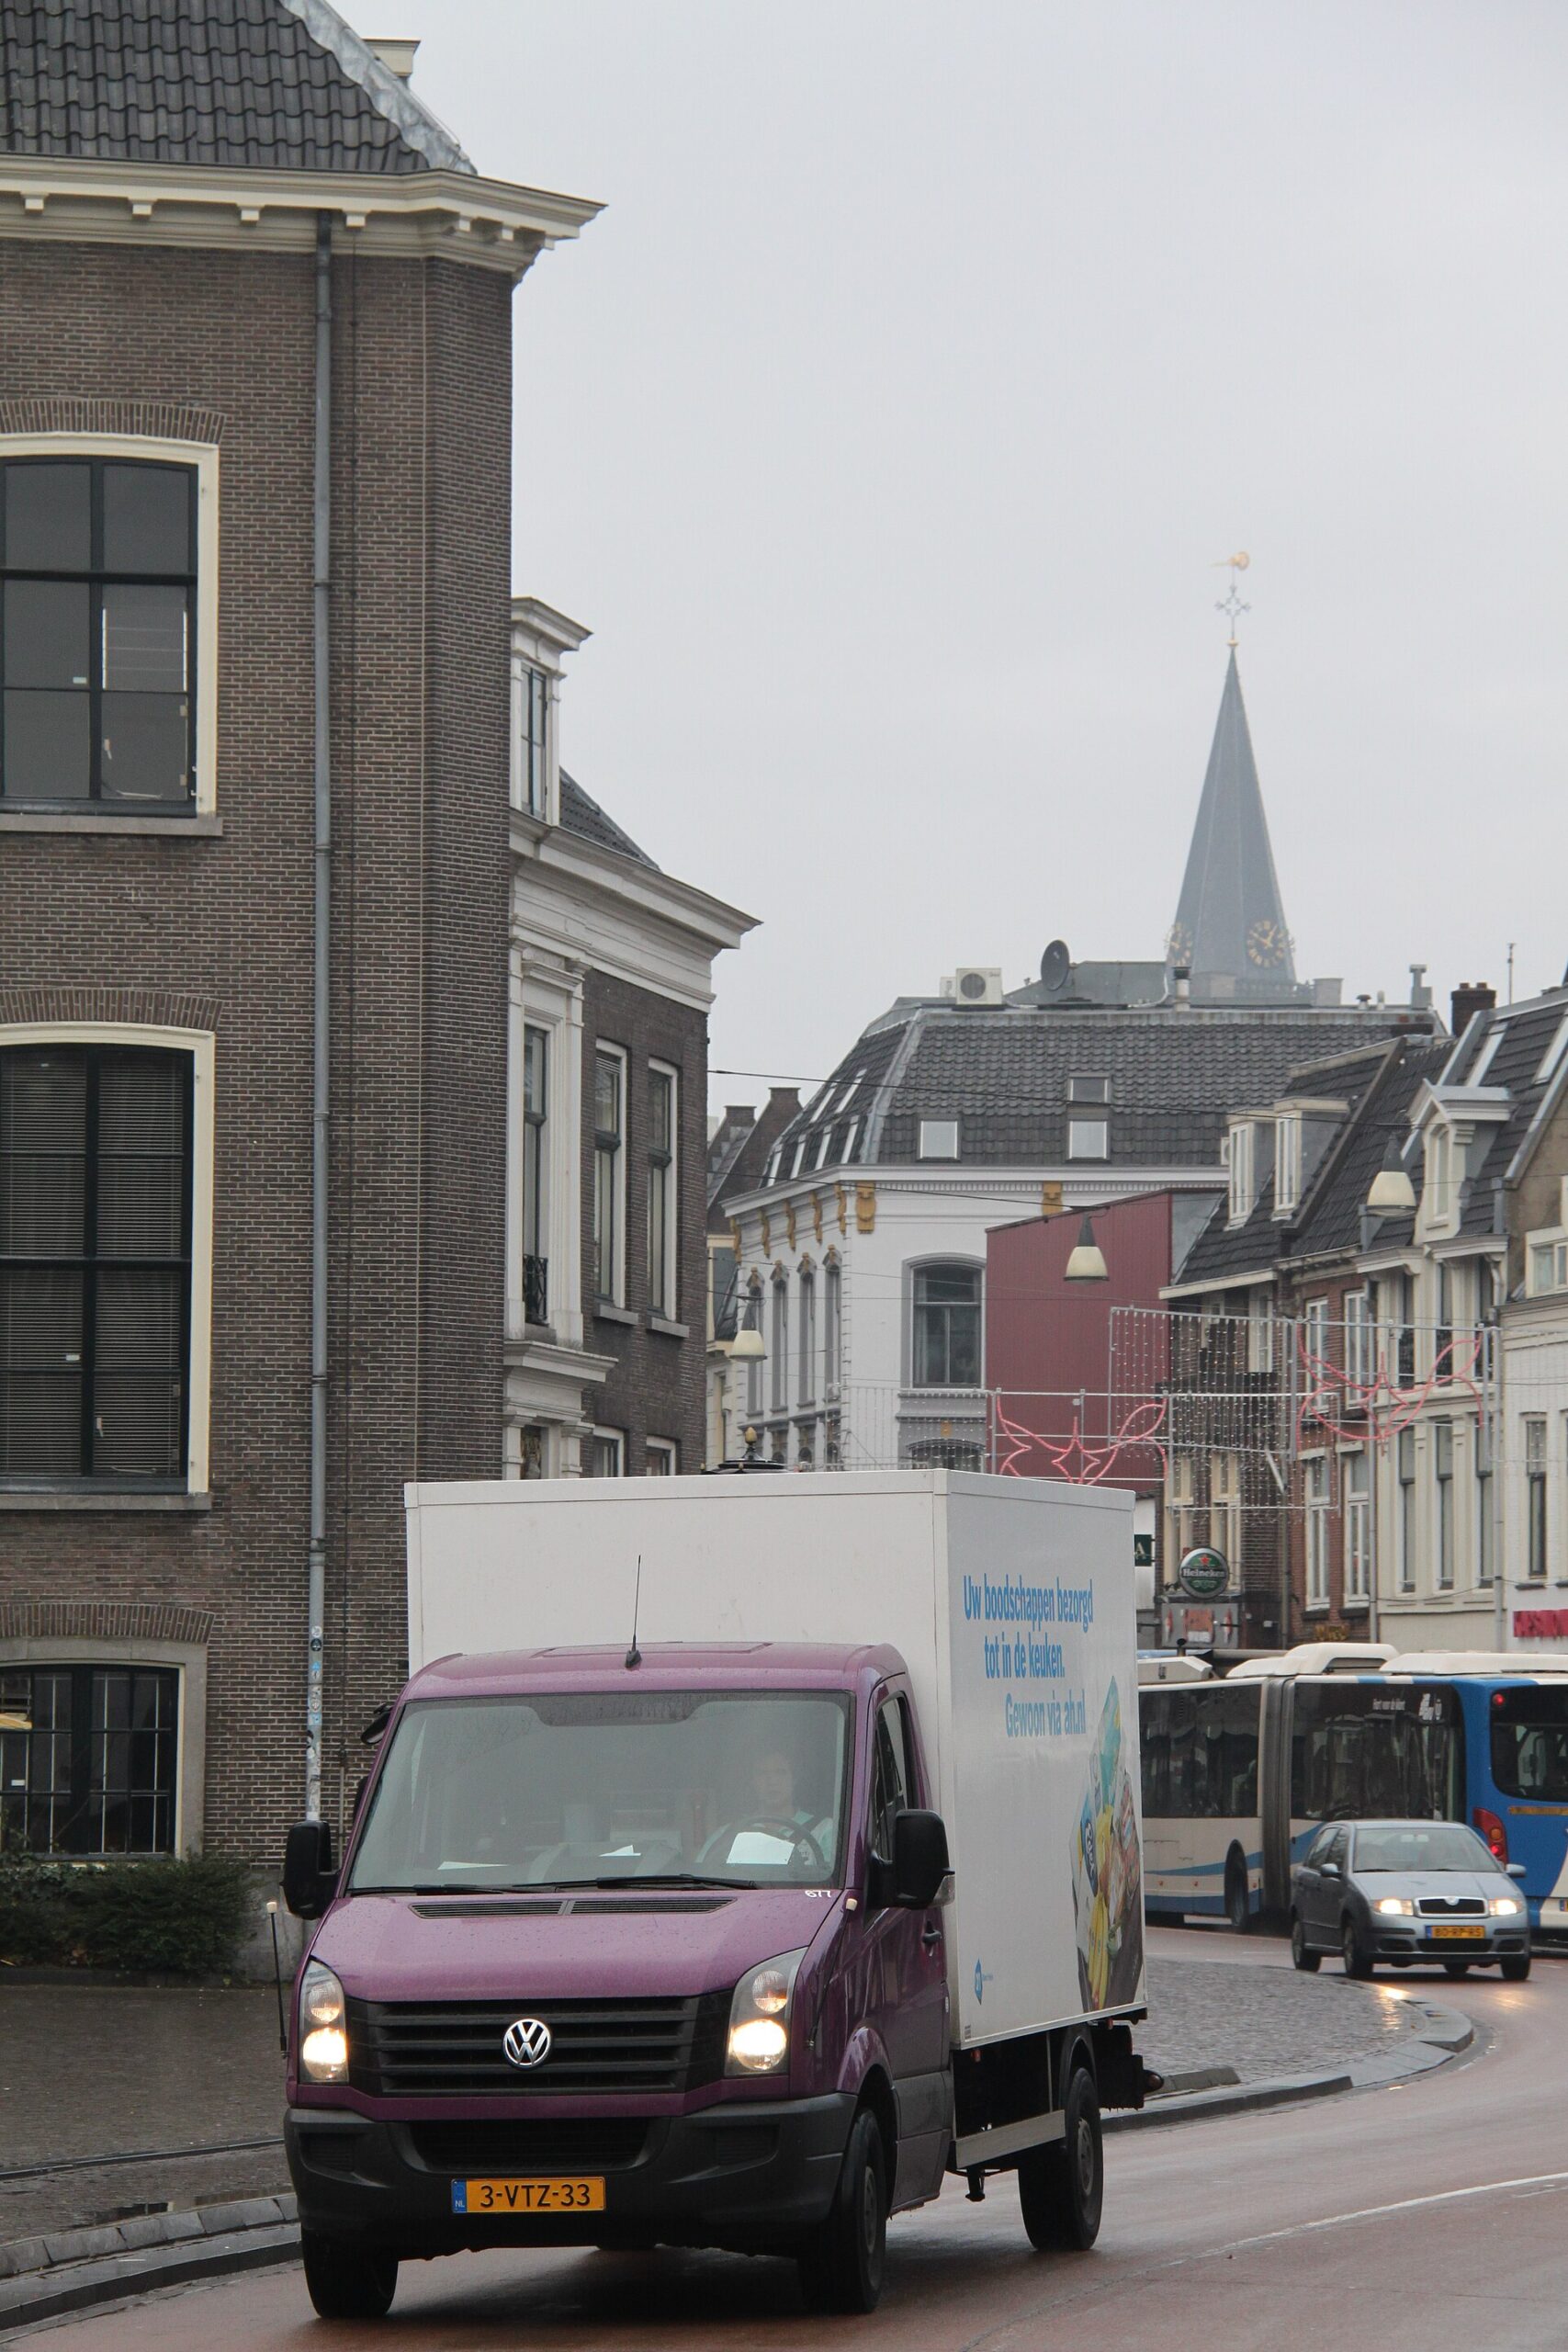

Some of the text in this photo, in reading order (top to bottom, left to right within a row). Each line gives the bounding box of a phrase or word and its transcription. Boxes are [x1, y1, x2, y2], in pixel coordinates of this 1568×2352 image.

[964, 1573, 1094, 1633] Uw boodschappen bezorgd
[984, 1632, 1066, 1679] tot in de keuken.
[1005, 1689, 1087, 1737] Gewoon via ah.nl
[455, 2199, 465, 2208] NL
[479, 2183, 591, 2209] 3-VTZ-33
